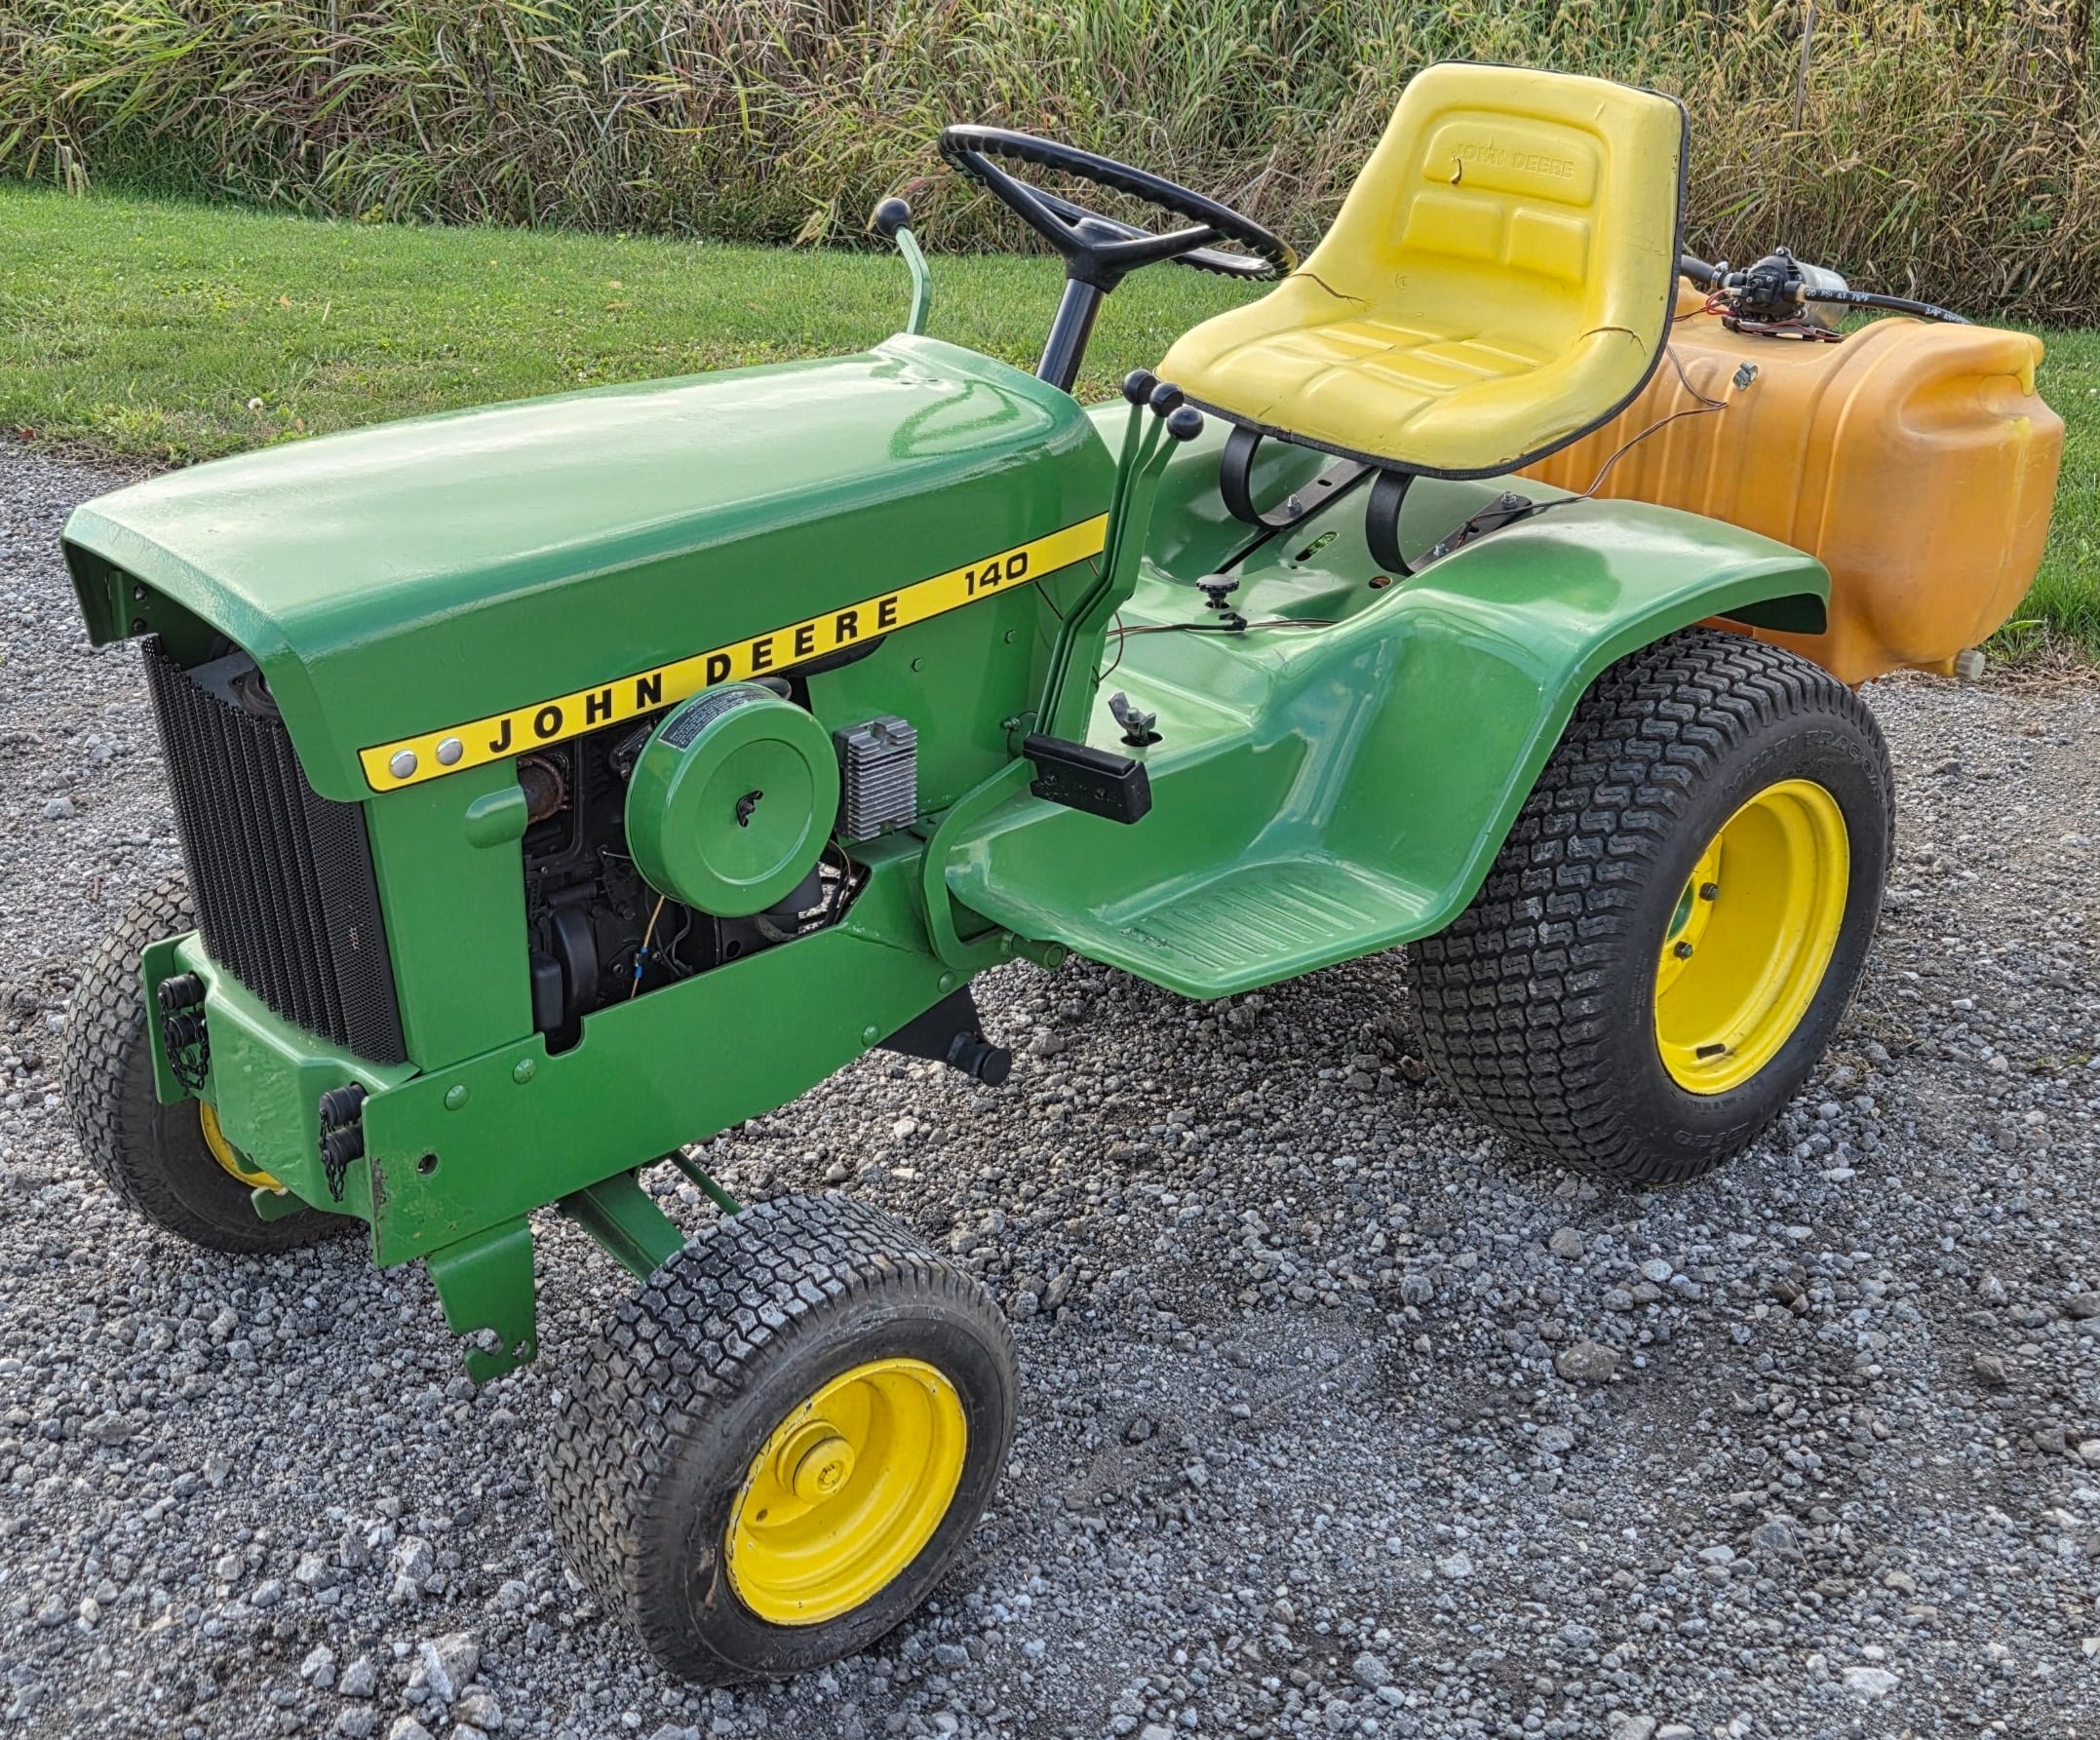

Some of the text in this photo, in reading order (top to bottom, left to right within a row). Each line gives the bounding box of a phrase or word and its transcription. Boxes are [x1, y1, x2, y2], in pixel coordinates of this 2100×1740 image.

[1512, 152, 1575, 179] DEERE
[489, 673, 662, 754] JOHN
[706, 596, 899, 687] DEERE
[964, 551, 1030, 597] 140
